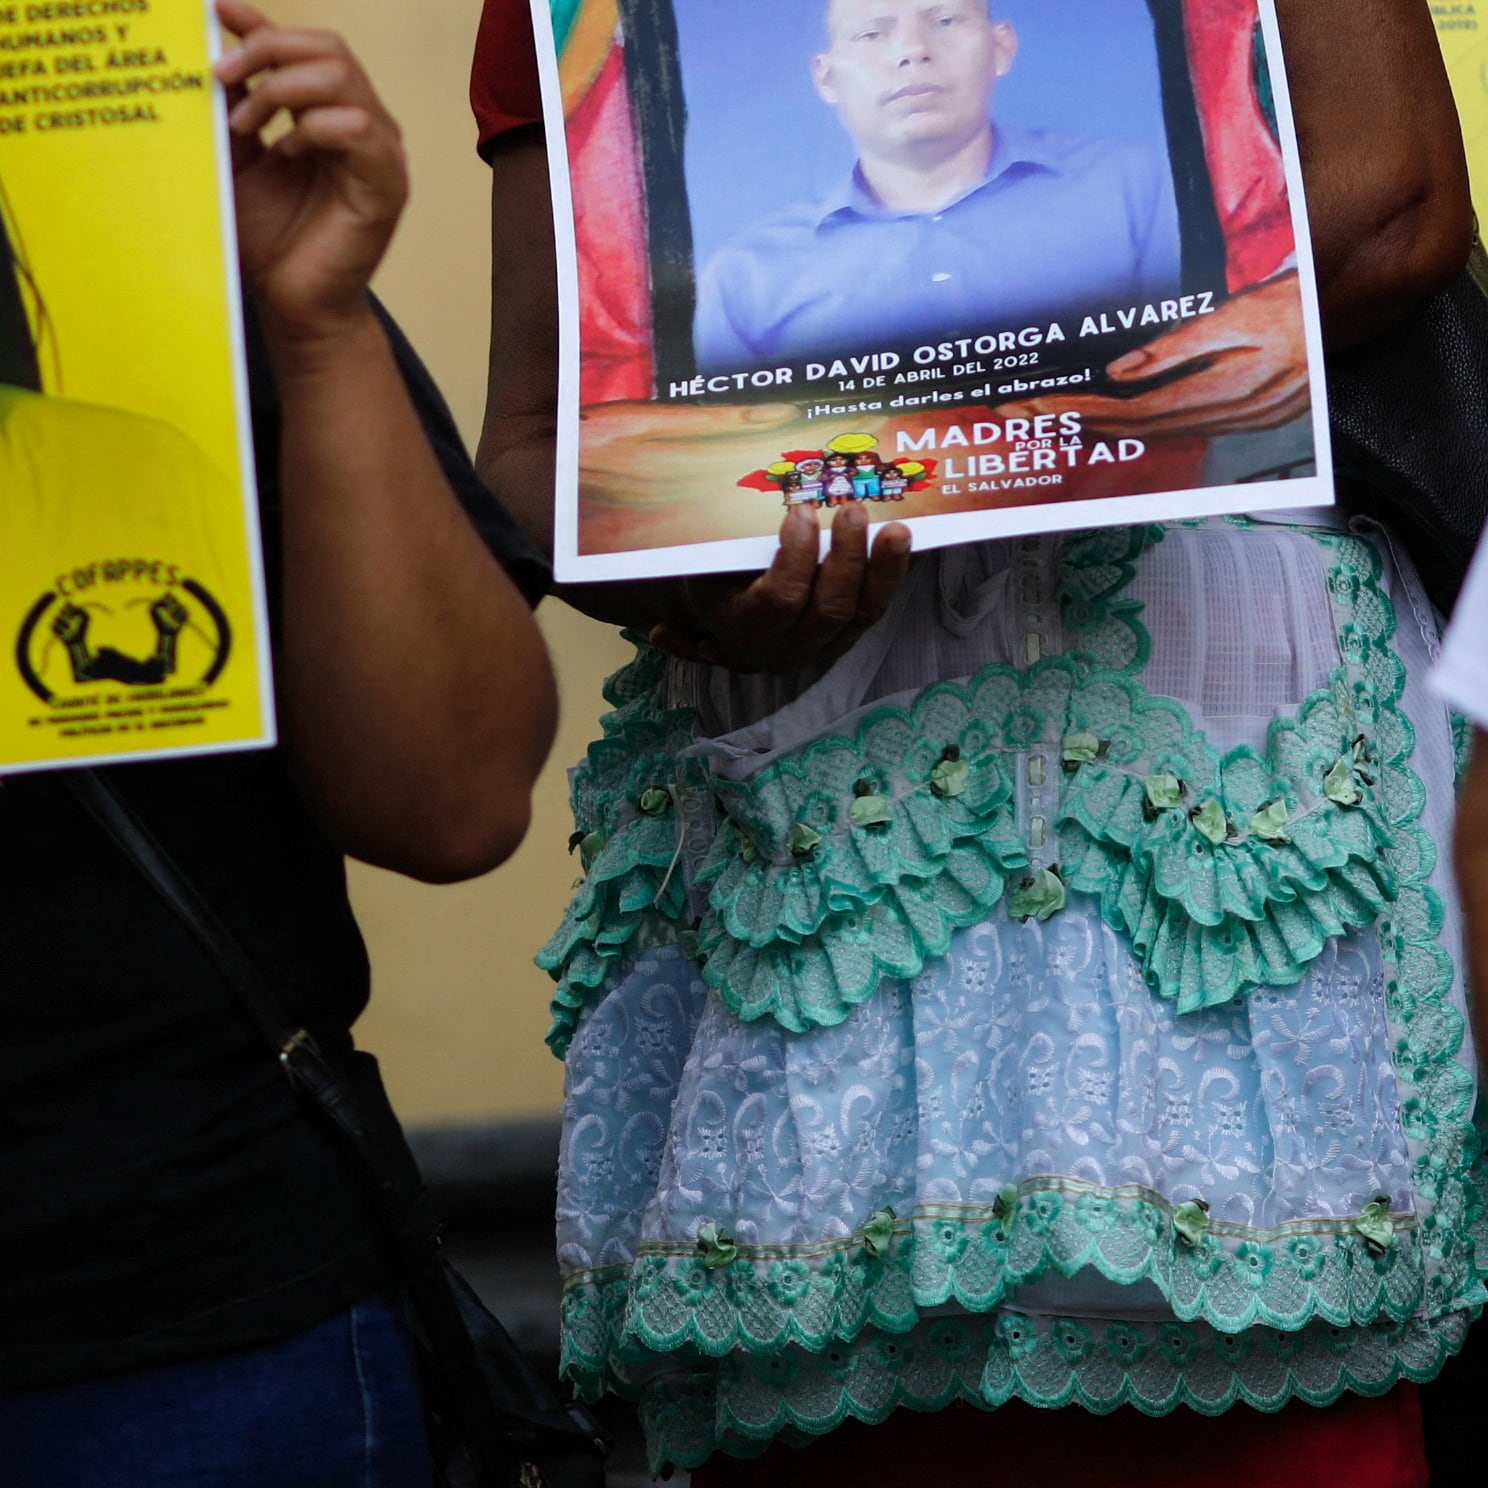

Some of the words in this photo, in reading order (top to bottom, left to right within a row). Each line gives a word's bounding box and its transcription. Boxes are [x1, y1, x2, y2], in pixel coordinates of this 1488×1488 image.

[115, 23, 128, 41] Y
[55, 55, 96, 75] DEL
[669, 367, 793, 398] HÉCTOR
[806, 352, 900, 381] DAVID
[913, 323, 1065, 365] OSTORGA
[1080, 291, 1215, 337] ALVAREZ
[838, 380, 856, 392] 14
[863, 376, 886, 389] DE
[893, 367, 946, 385] ABRIL
[953, 361, 986, 376] DEL
[993, 352, 1039, 370] 2022
[807, 401, 882, 419] ¡Hasta
[890, 389, 964, 408] darles
[971, 383, 991, 398] el
[997, 368, 1091, 394] abrazo!
[895, 411, 1082, 453] MADRES
[1015, 438, 1052, 452] POR
[1059, 434, 1082, 448] LA
[943, 438, 1146, 480] LIBERTAD
[942, 483, 961, 495] EL
[968, 474, 1063, 492] SALVADOR
